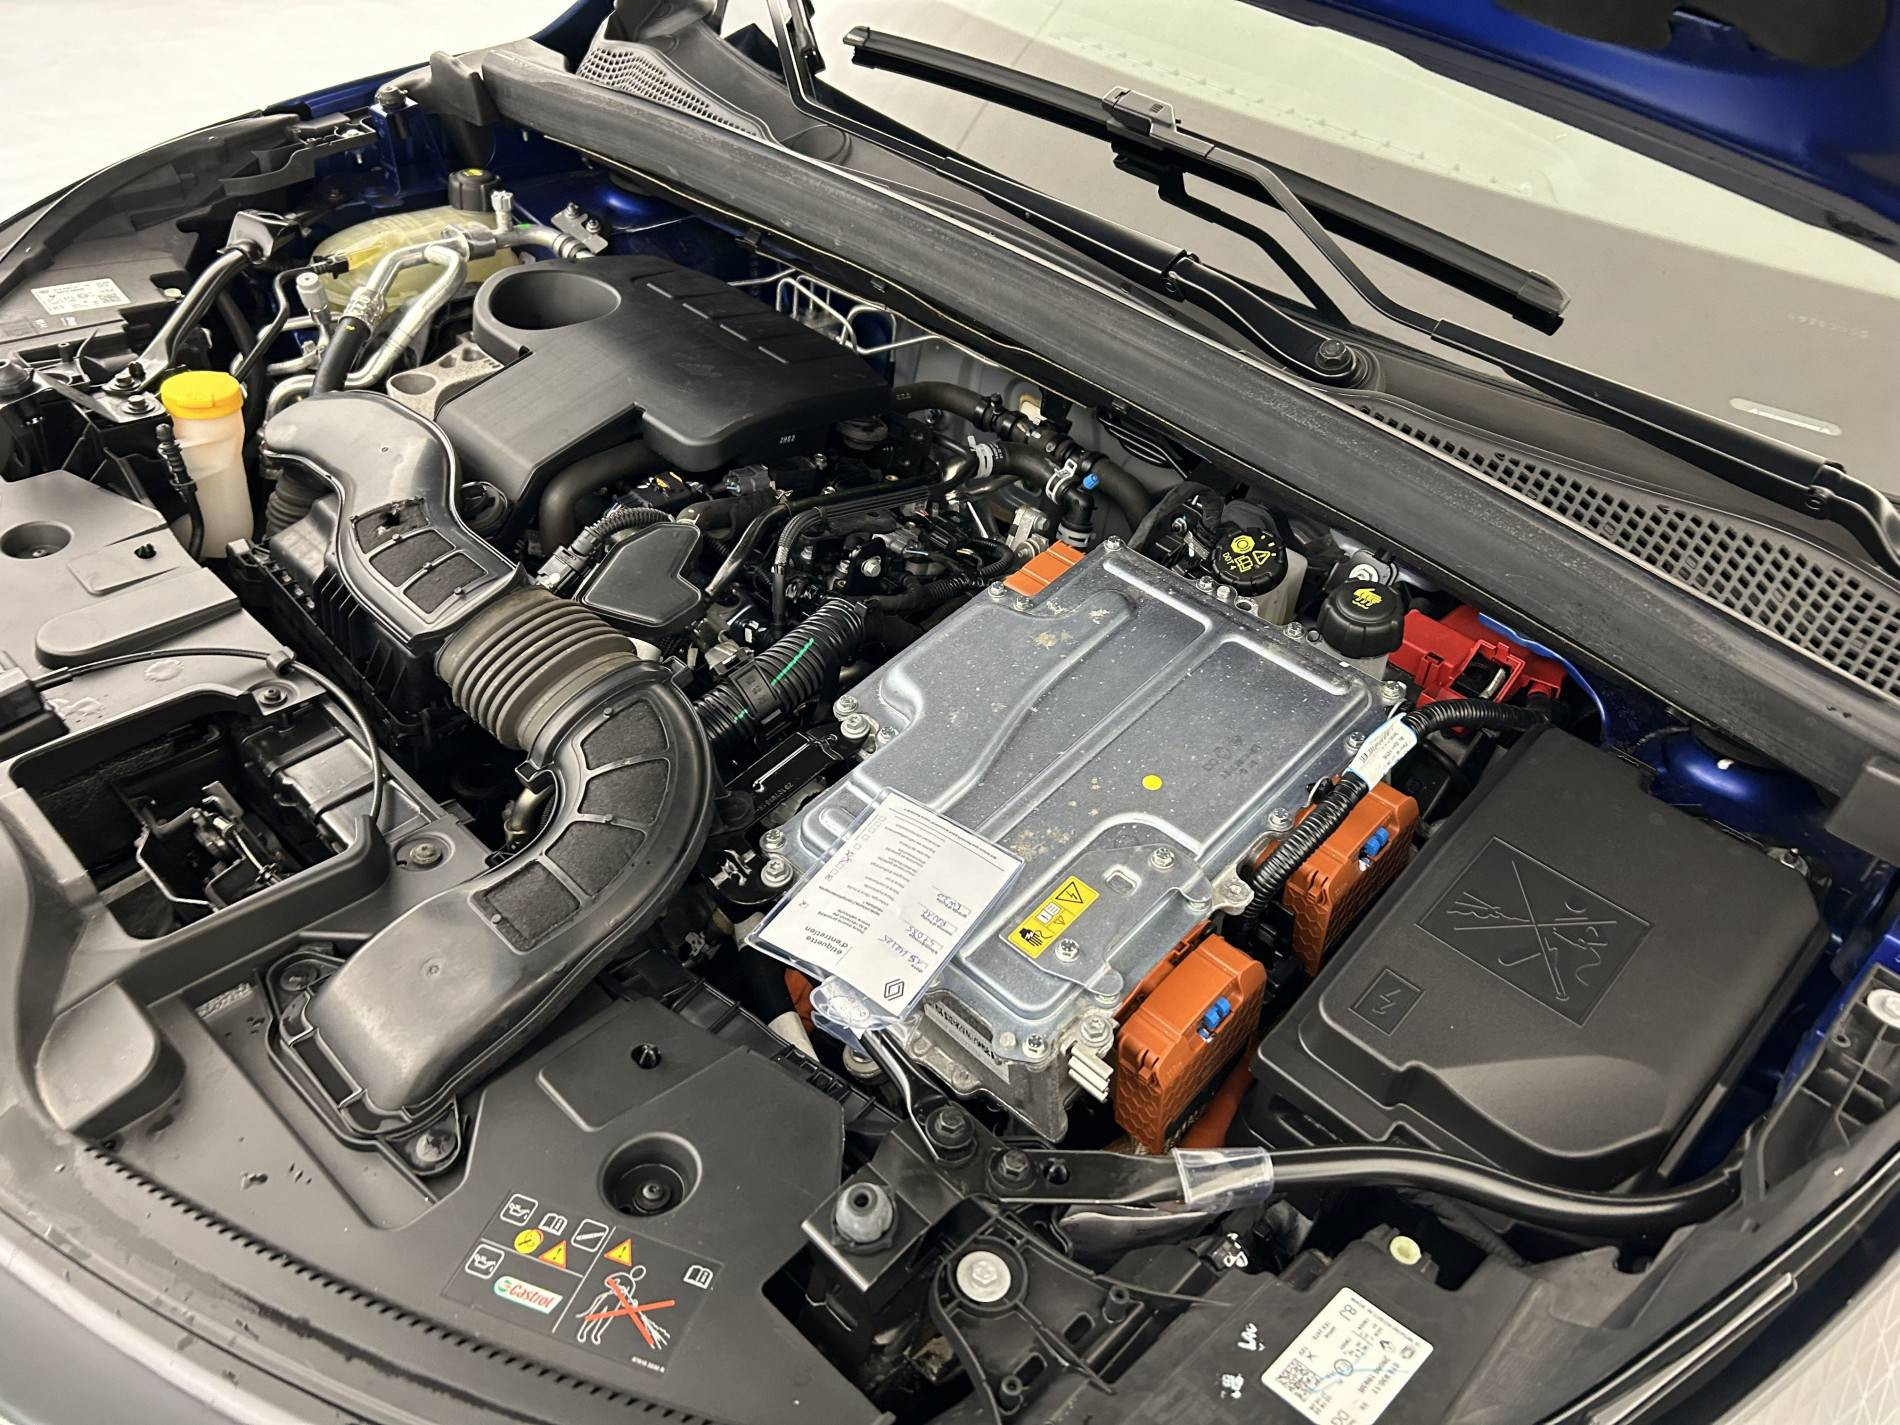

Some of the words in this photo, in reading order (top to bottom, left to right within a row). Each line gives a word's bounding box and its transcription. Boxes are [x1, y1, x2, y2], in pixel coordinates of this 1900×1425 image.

[1222, 551, 1235, 565] DOT
[804, 925, 849, 949] d'entretien
[805, 935, 843, 956] étiquette
[509, 1283, 556, 1309] Castrol
